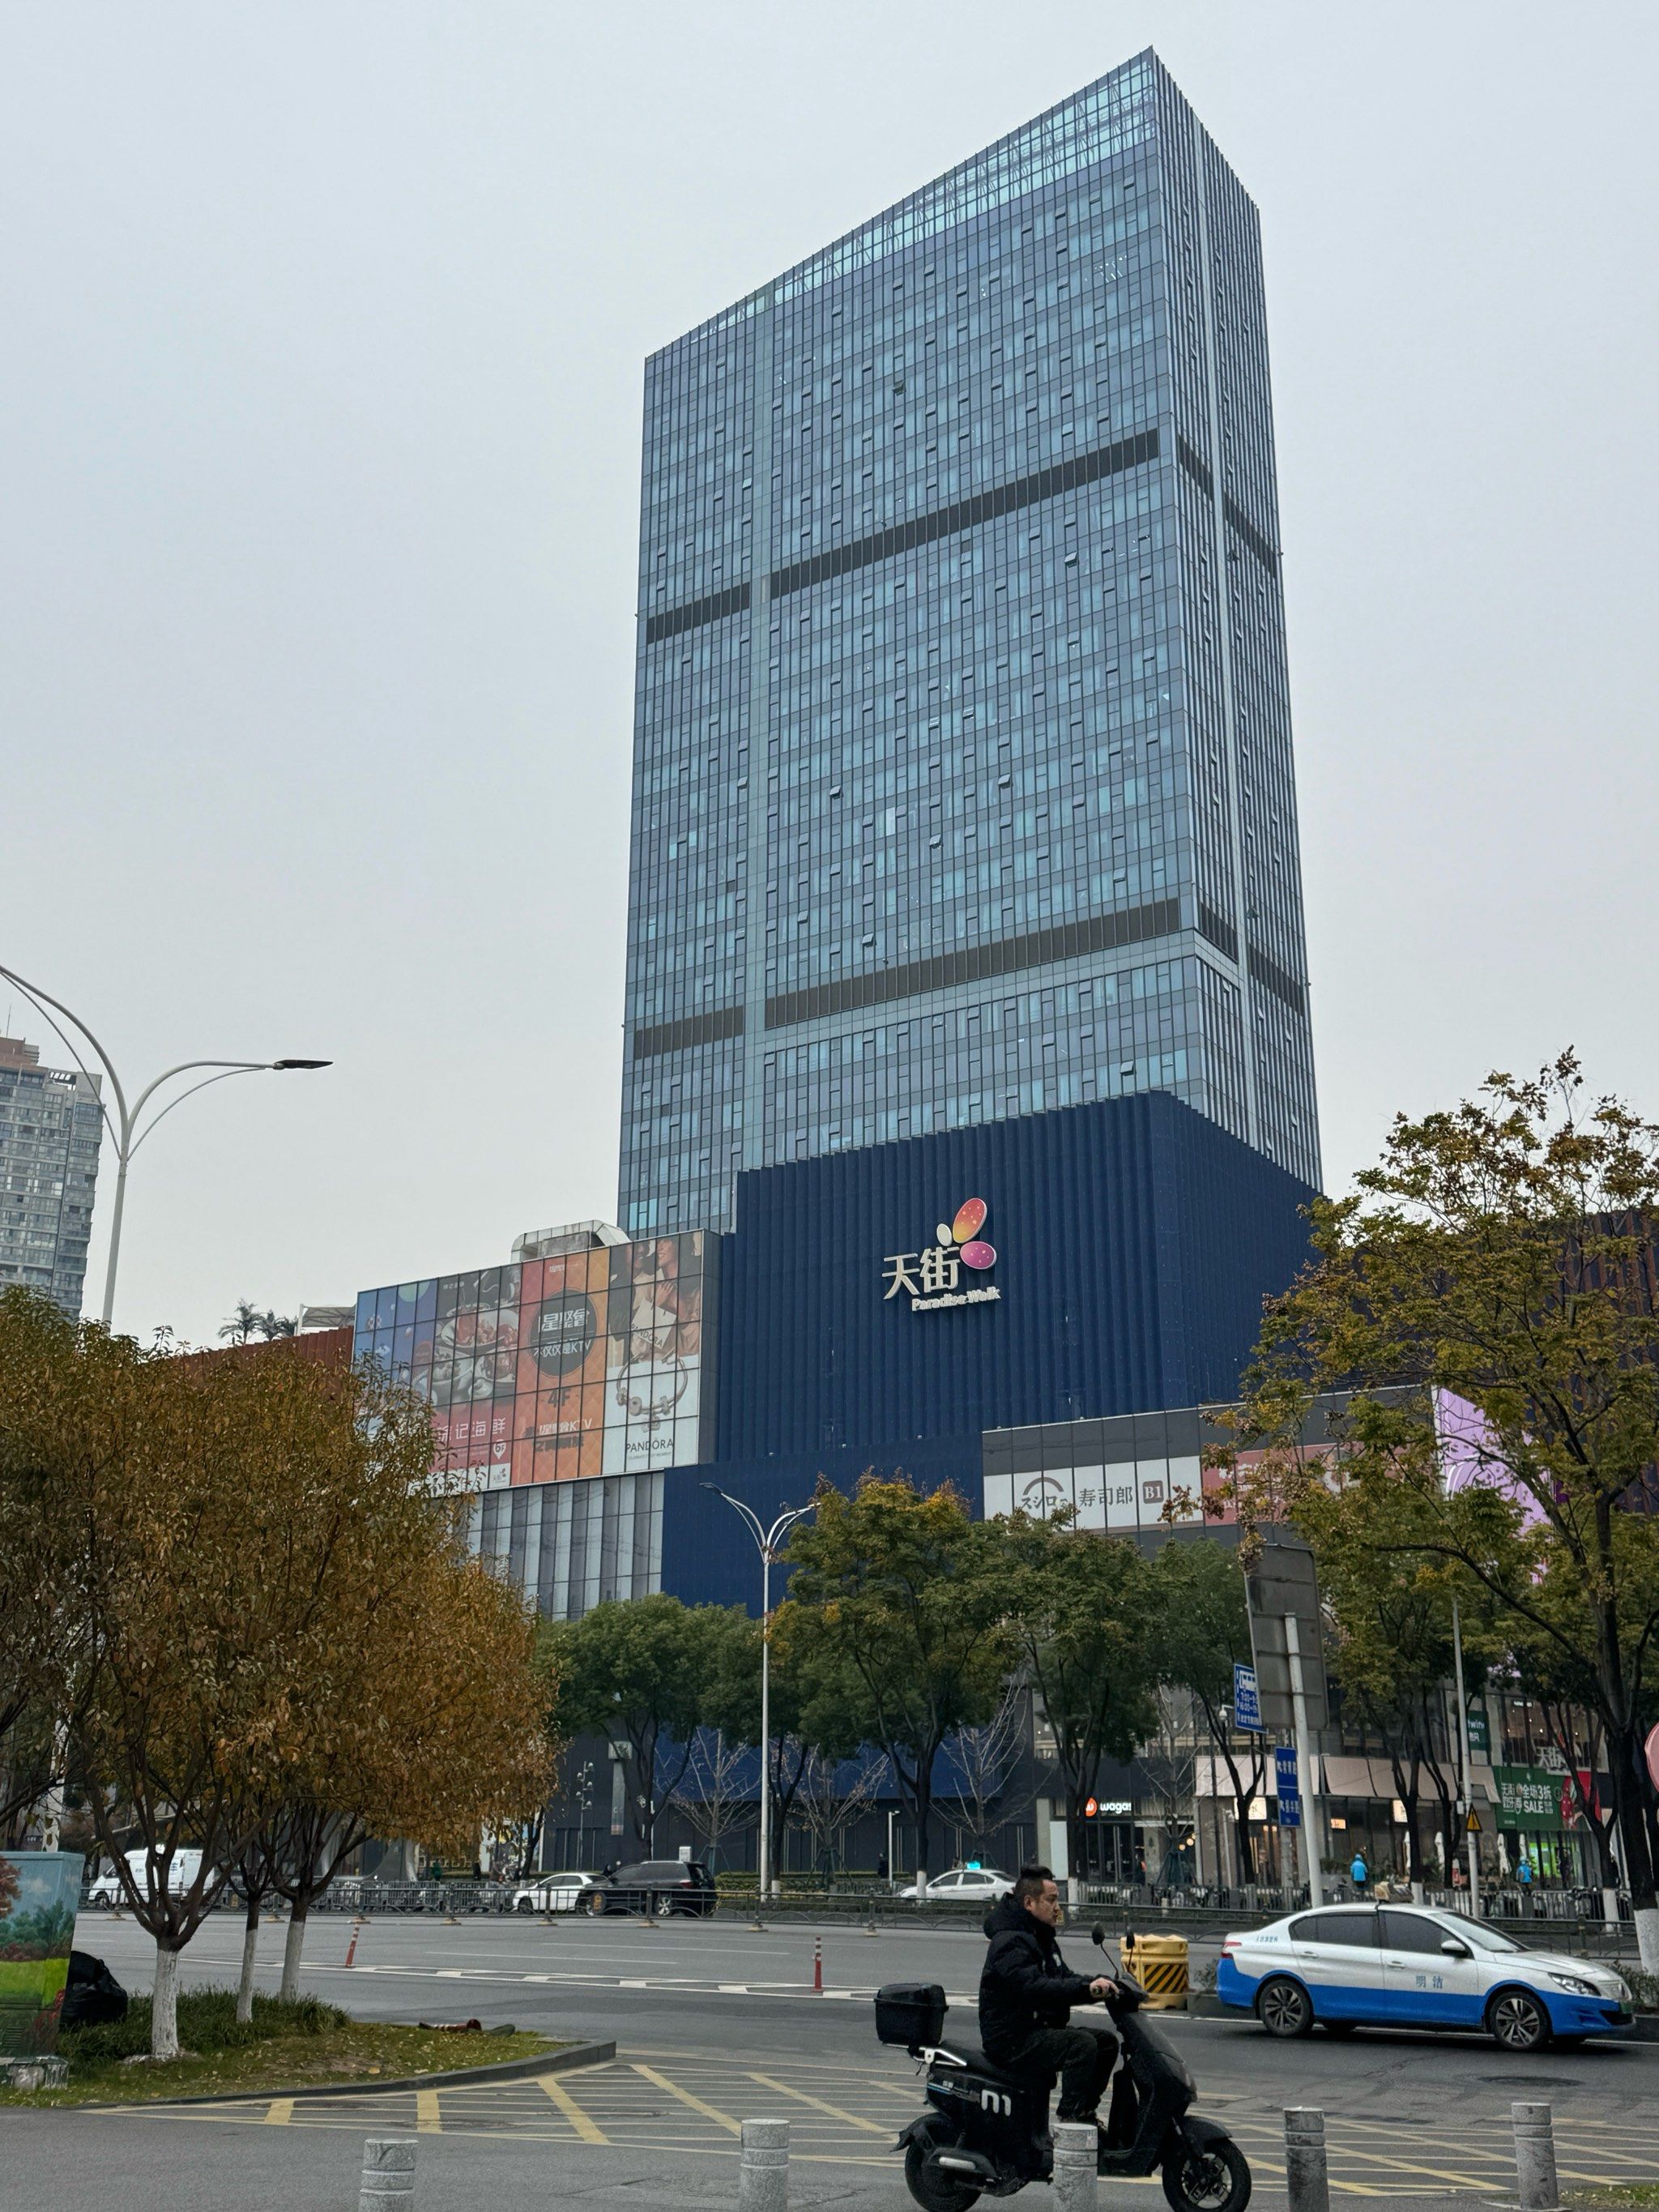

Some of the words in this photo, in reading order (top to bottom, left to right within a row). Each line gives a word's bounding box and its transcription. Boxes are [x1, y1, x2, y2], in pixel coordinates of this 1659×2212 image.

[882, 1246, 961, 1300] 天街
[911, 1293, 967, 1312] Paradise
[967, 1286, 1001, 1304] Walk
[631, 1324, 663, 1347] PANDORA
[548, 1386, 571, 1407] 4F
[626, 1437, 674, 1453] PANDORA
[1079, 1486, 1133, 1507] 寿司郎
[1144, 1485, 1162, 1500] B1
[1523, 1800, 1544, 1813] SALE
